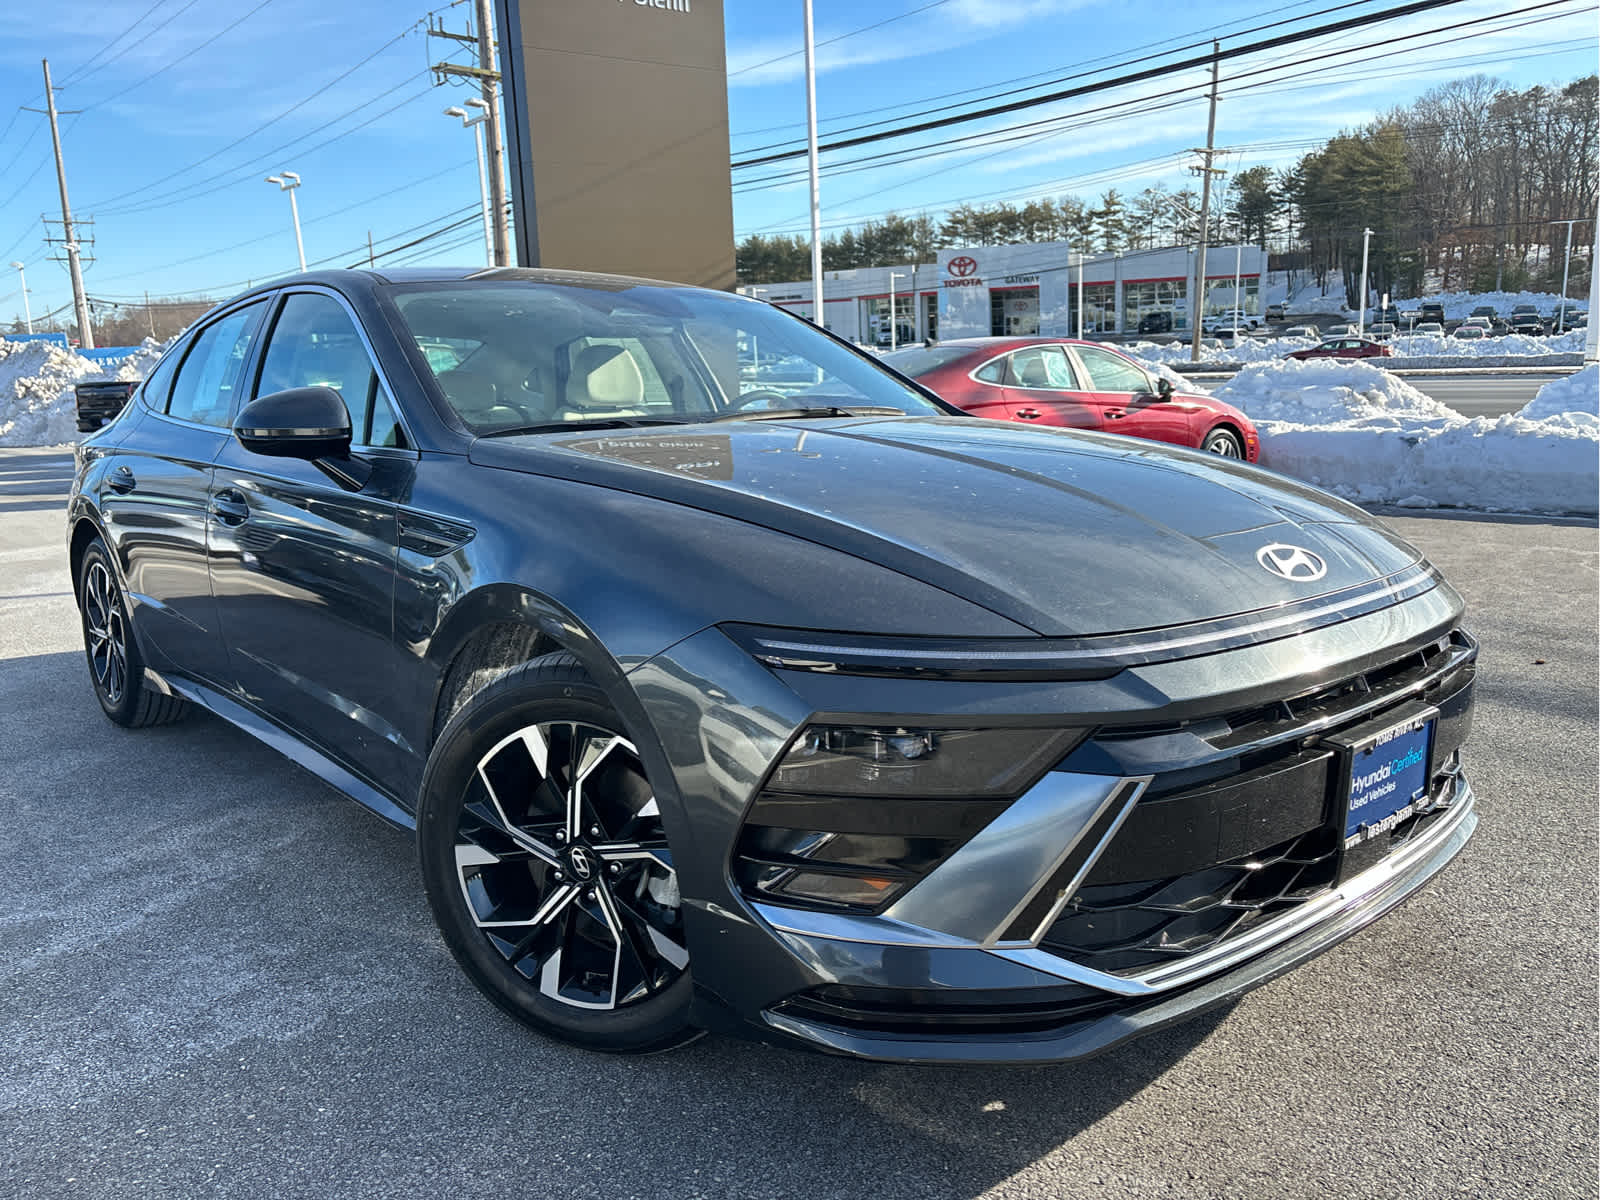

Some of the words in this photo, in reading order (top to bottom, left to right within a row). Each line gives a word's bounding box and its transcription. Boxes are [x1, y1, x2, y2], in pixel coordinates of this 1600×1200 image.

[943, 278, 983, 288] TOYOTA
[1004, 275, 1040, 285] GATEWAY
[1351, 762, 1391, 793] Hyundai
[1391, 747, 1423, 775] Certified
[1349, 793, 1369, 811] Used
[1369, 781, 1396, 801] Vehicles
